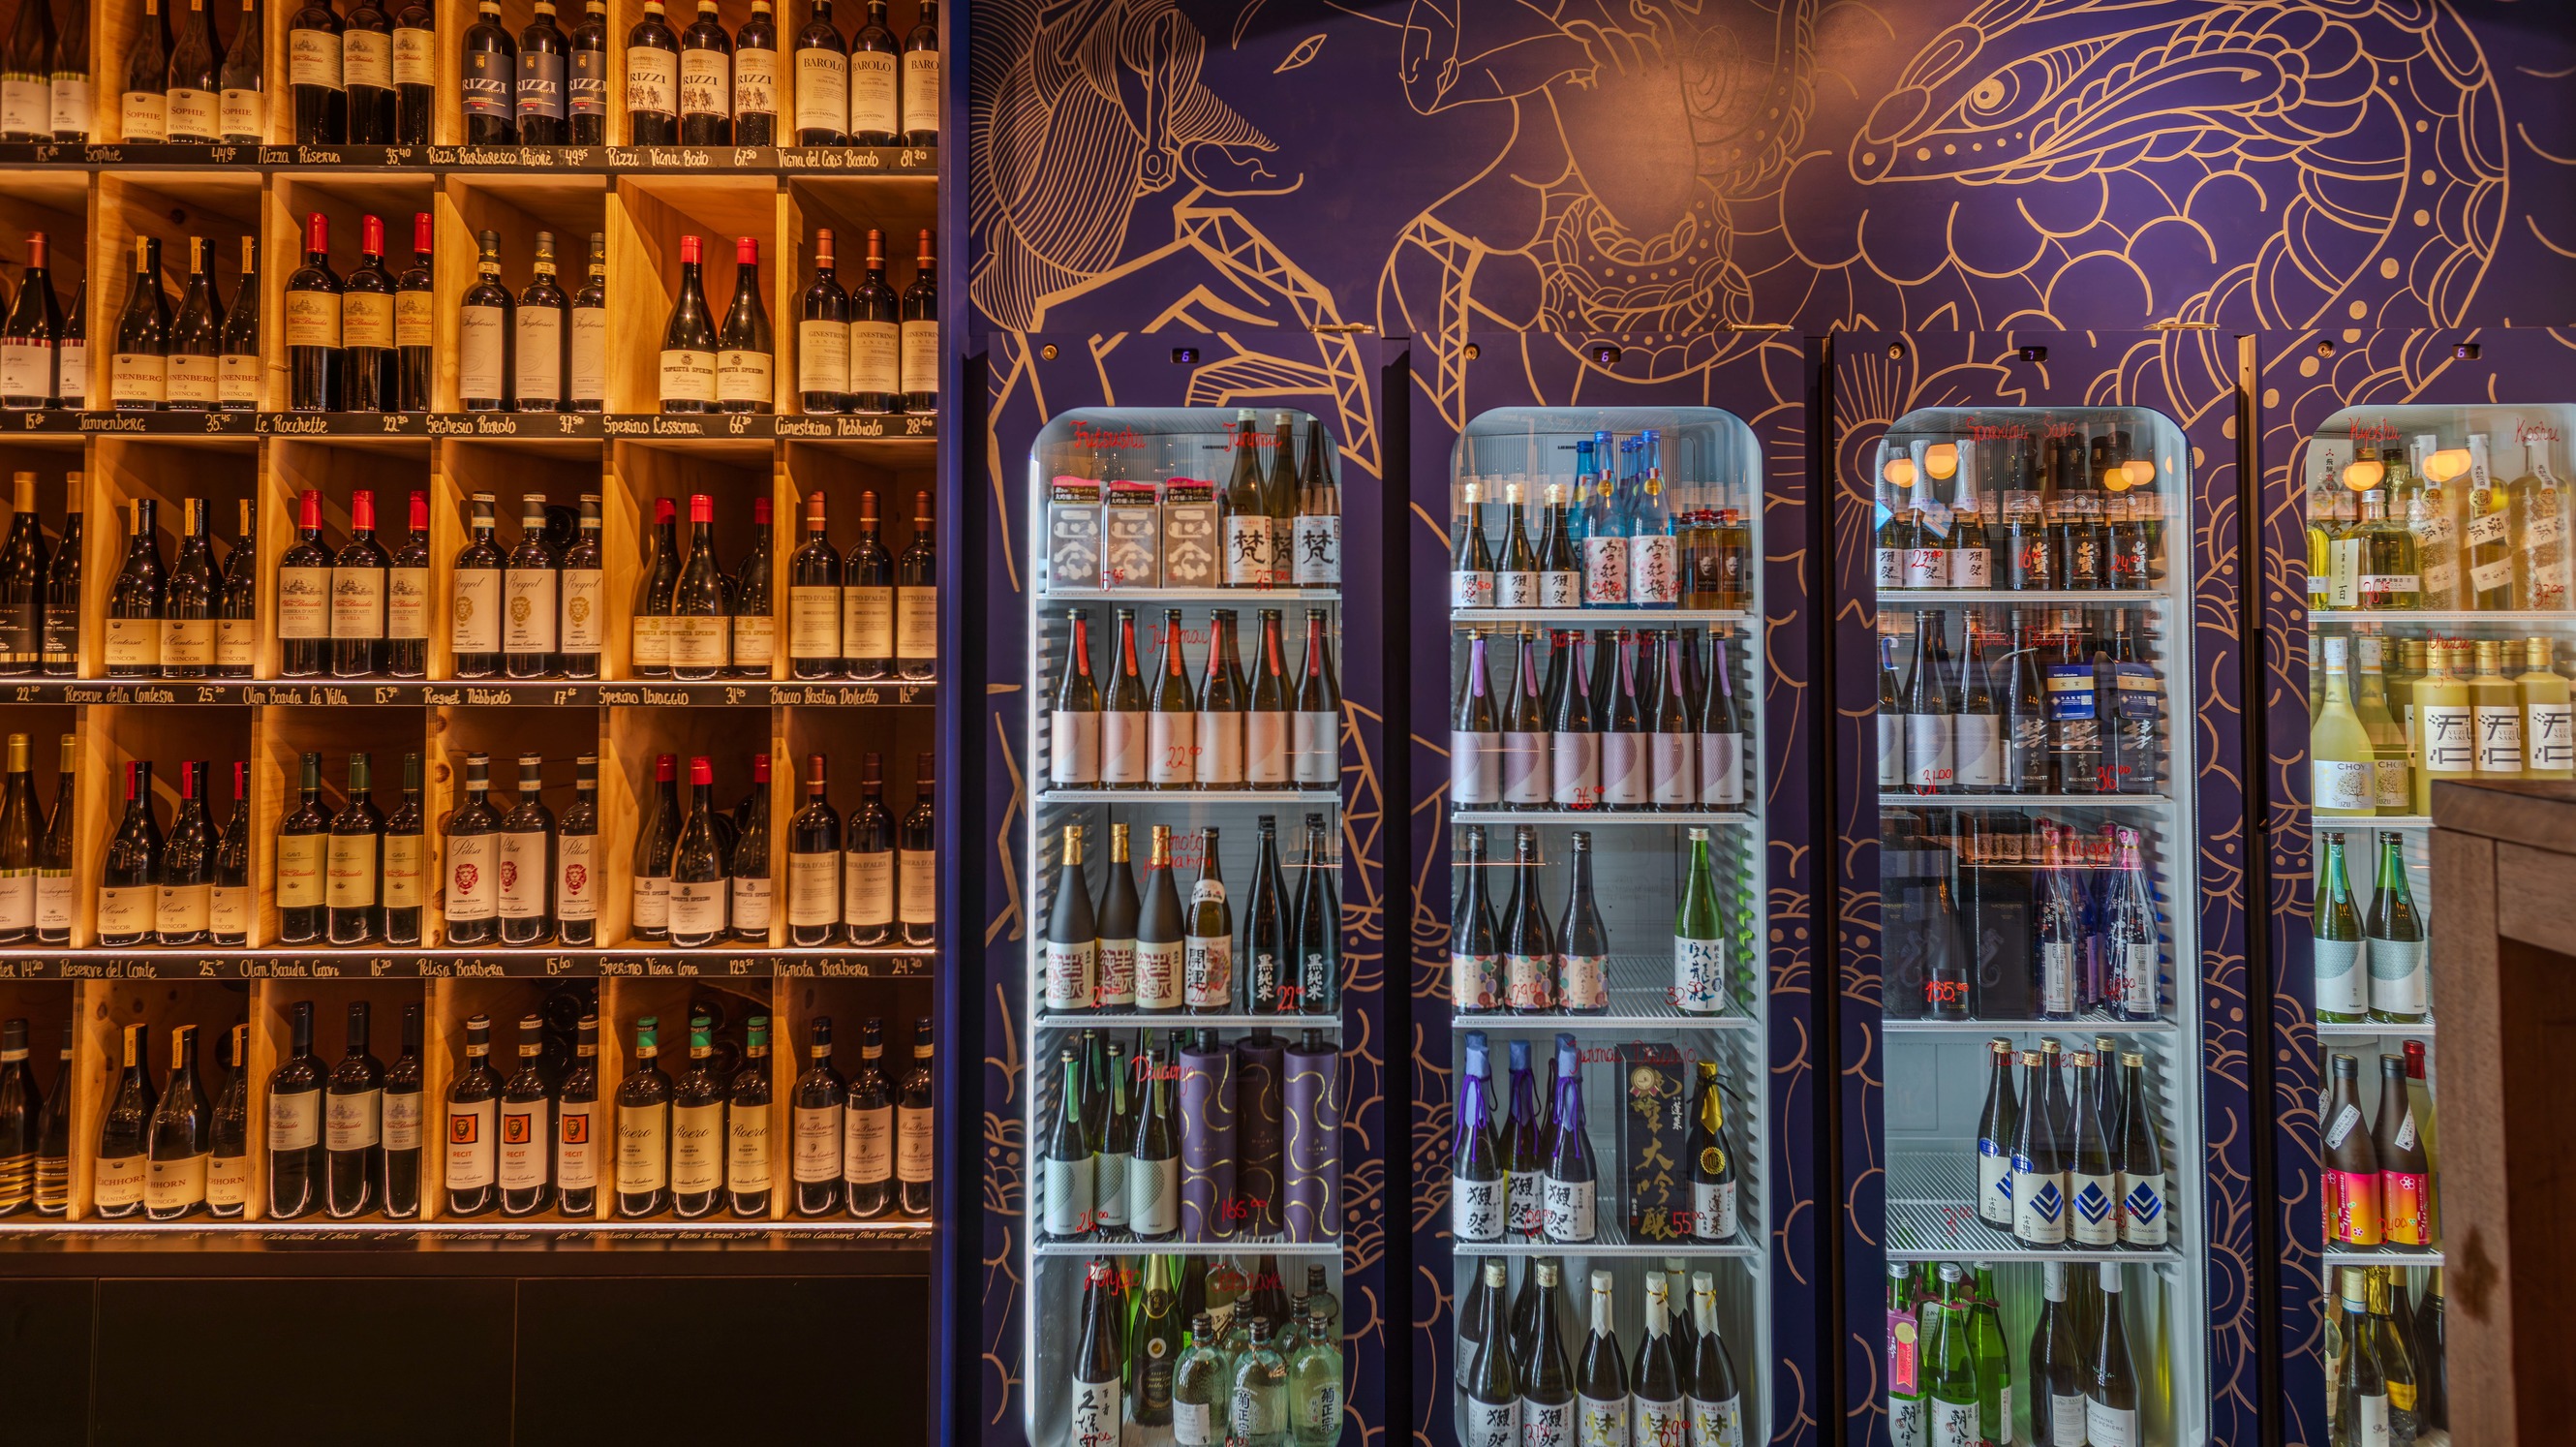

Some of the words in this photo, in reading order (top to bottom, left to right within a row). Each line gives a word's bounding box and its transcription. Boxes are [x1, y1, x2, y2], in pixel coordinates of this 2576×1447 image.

[804, 57, 844, 73] BAROLO
[853, 60, 891, 73] BAROLO
[463, 77, 506, 94] RIZZI
[517, 78, 557, 94] RIZZI
[629, 72, 666, 84] RIZZI
[683, 75, 718, 85] RIZZI
[126, 109, 161, 121] SOPHIE
[170, 106, 206, 117] SOPHIE
[85, 146, 123, 165] Sophie
[258, 148, 291, 165] Nizza
[298, 146, 341, 165] Riserva
[427, 147, 456, 165] Rizzi
[457, 147, 517, 166] Barbaresco
[606, 148, 639, 166] Rizzi
[650, 149, 680, 168] Vigna
[776, 149, 805, 168] Vigna
[806, 149, 820, 167] del
[845, 149, 879, 167] Barolo
[1181, 351, 1190, 362] 6
[1602, 351, 1610, 362] 6
[2457, 347, 2466, 358] 6
[255, 414, 269, 433] Le
[273, 414, 327, 434] Rocchette
[426, 416, 474, 434] Seghesio
[478, 416, 517, 434] Barolo
[603, 416, 649, 436] Sperino
[653, 416, 698, 435] Lessona
[775, 417, 832, 436] Ginestrino
[837, 418, 882, 436] Nebbiolo
[2515, 417, 2561, 444] Koshu
[1222, 421, 1283, 452] Junmai
[1146, 624, 1209, 655] Junmai
[63, 686, 103, 704] Reserve
[107, 686, 131, 703] della
[135, 686, 175, 704] Contessa
[242, 686, 266, 705] Olim
[269, 686, 303, 705] Bauda
[309, 686, 322, 705] La
[325, 687, 349, 705] Villa
[598, 687, 639, 706] Sperino
[770, 687, 801, 705] Bricco
[804, 687, 836, 705] Bastia
[839, 687, 878, 705] Dolcetto
[60, 959, 104, 977] Reserve
[106, 960, 123, 978] del
[126, 960, 157, 978] Conte
[239, 959, 270, 978] Olim
[270, 960, 307, 978] Bauda
[313, 958, 340, 977] Gavi
[415, 958, 451, 977] Pelisa
[454, 958, 506, 977] Barbera
[599, 957, 643, 976] Sperino
[646, 958, 674, 976] Vigna
[769, 958, 813, 976] Vignota
[819, 958, 870, 976] Barbera
[1256, 953, 1275, 1001] 黒純米
[1305, 953, 1325, 1001] 黒純米
[506, 1150, 526, 1158] RECIT
